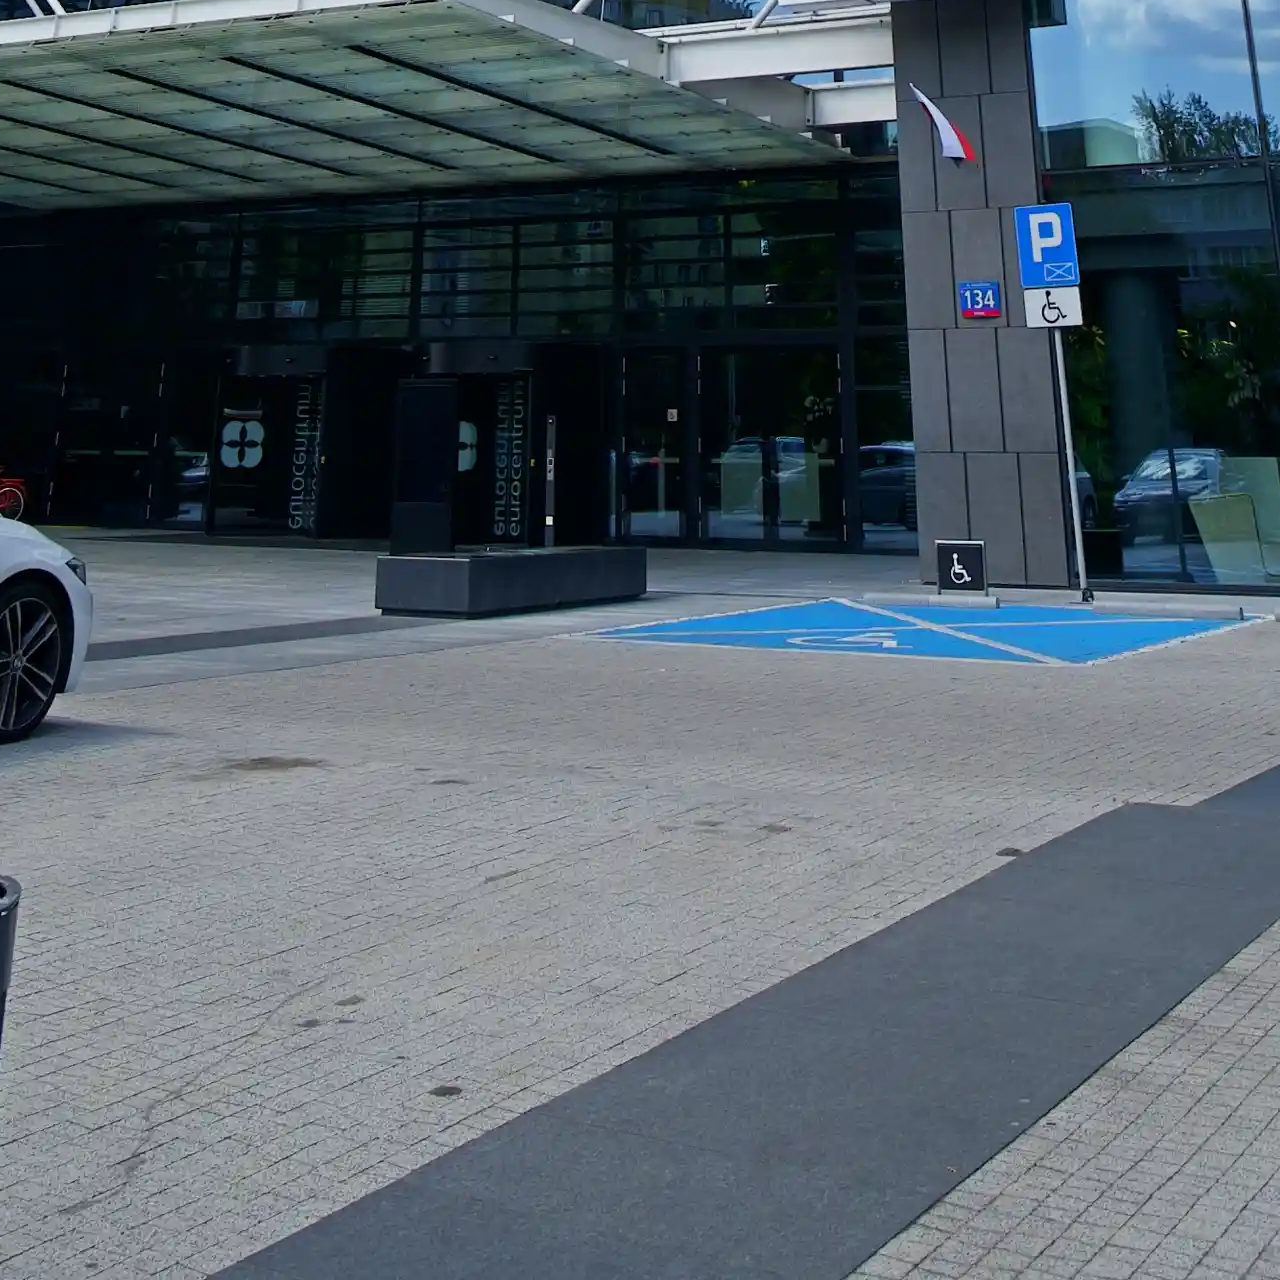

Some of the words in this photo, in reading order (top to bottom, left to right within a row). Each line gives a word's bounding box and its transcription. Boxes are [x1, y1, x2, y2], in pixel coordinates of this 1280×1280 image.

[1028, 211, 1063, 263] P
[964, 289, 995, 309] 134
[509, 380, 526, 537] eurocentrum
